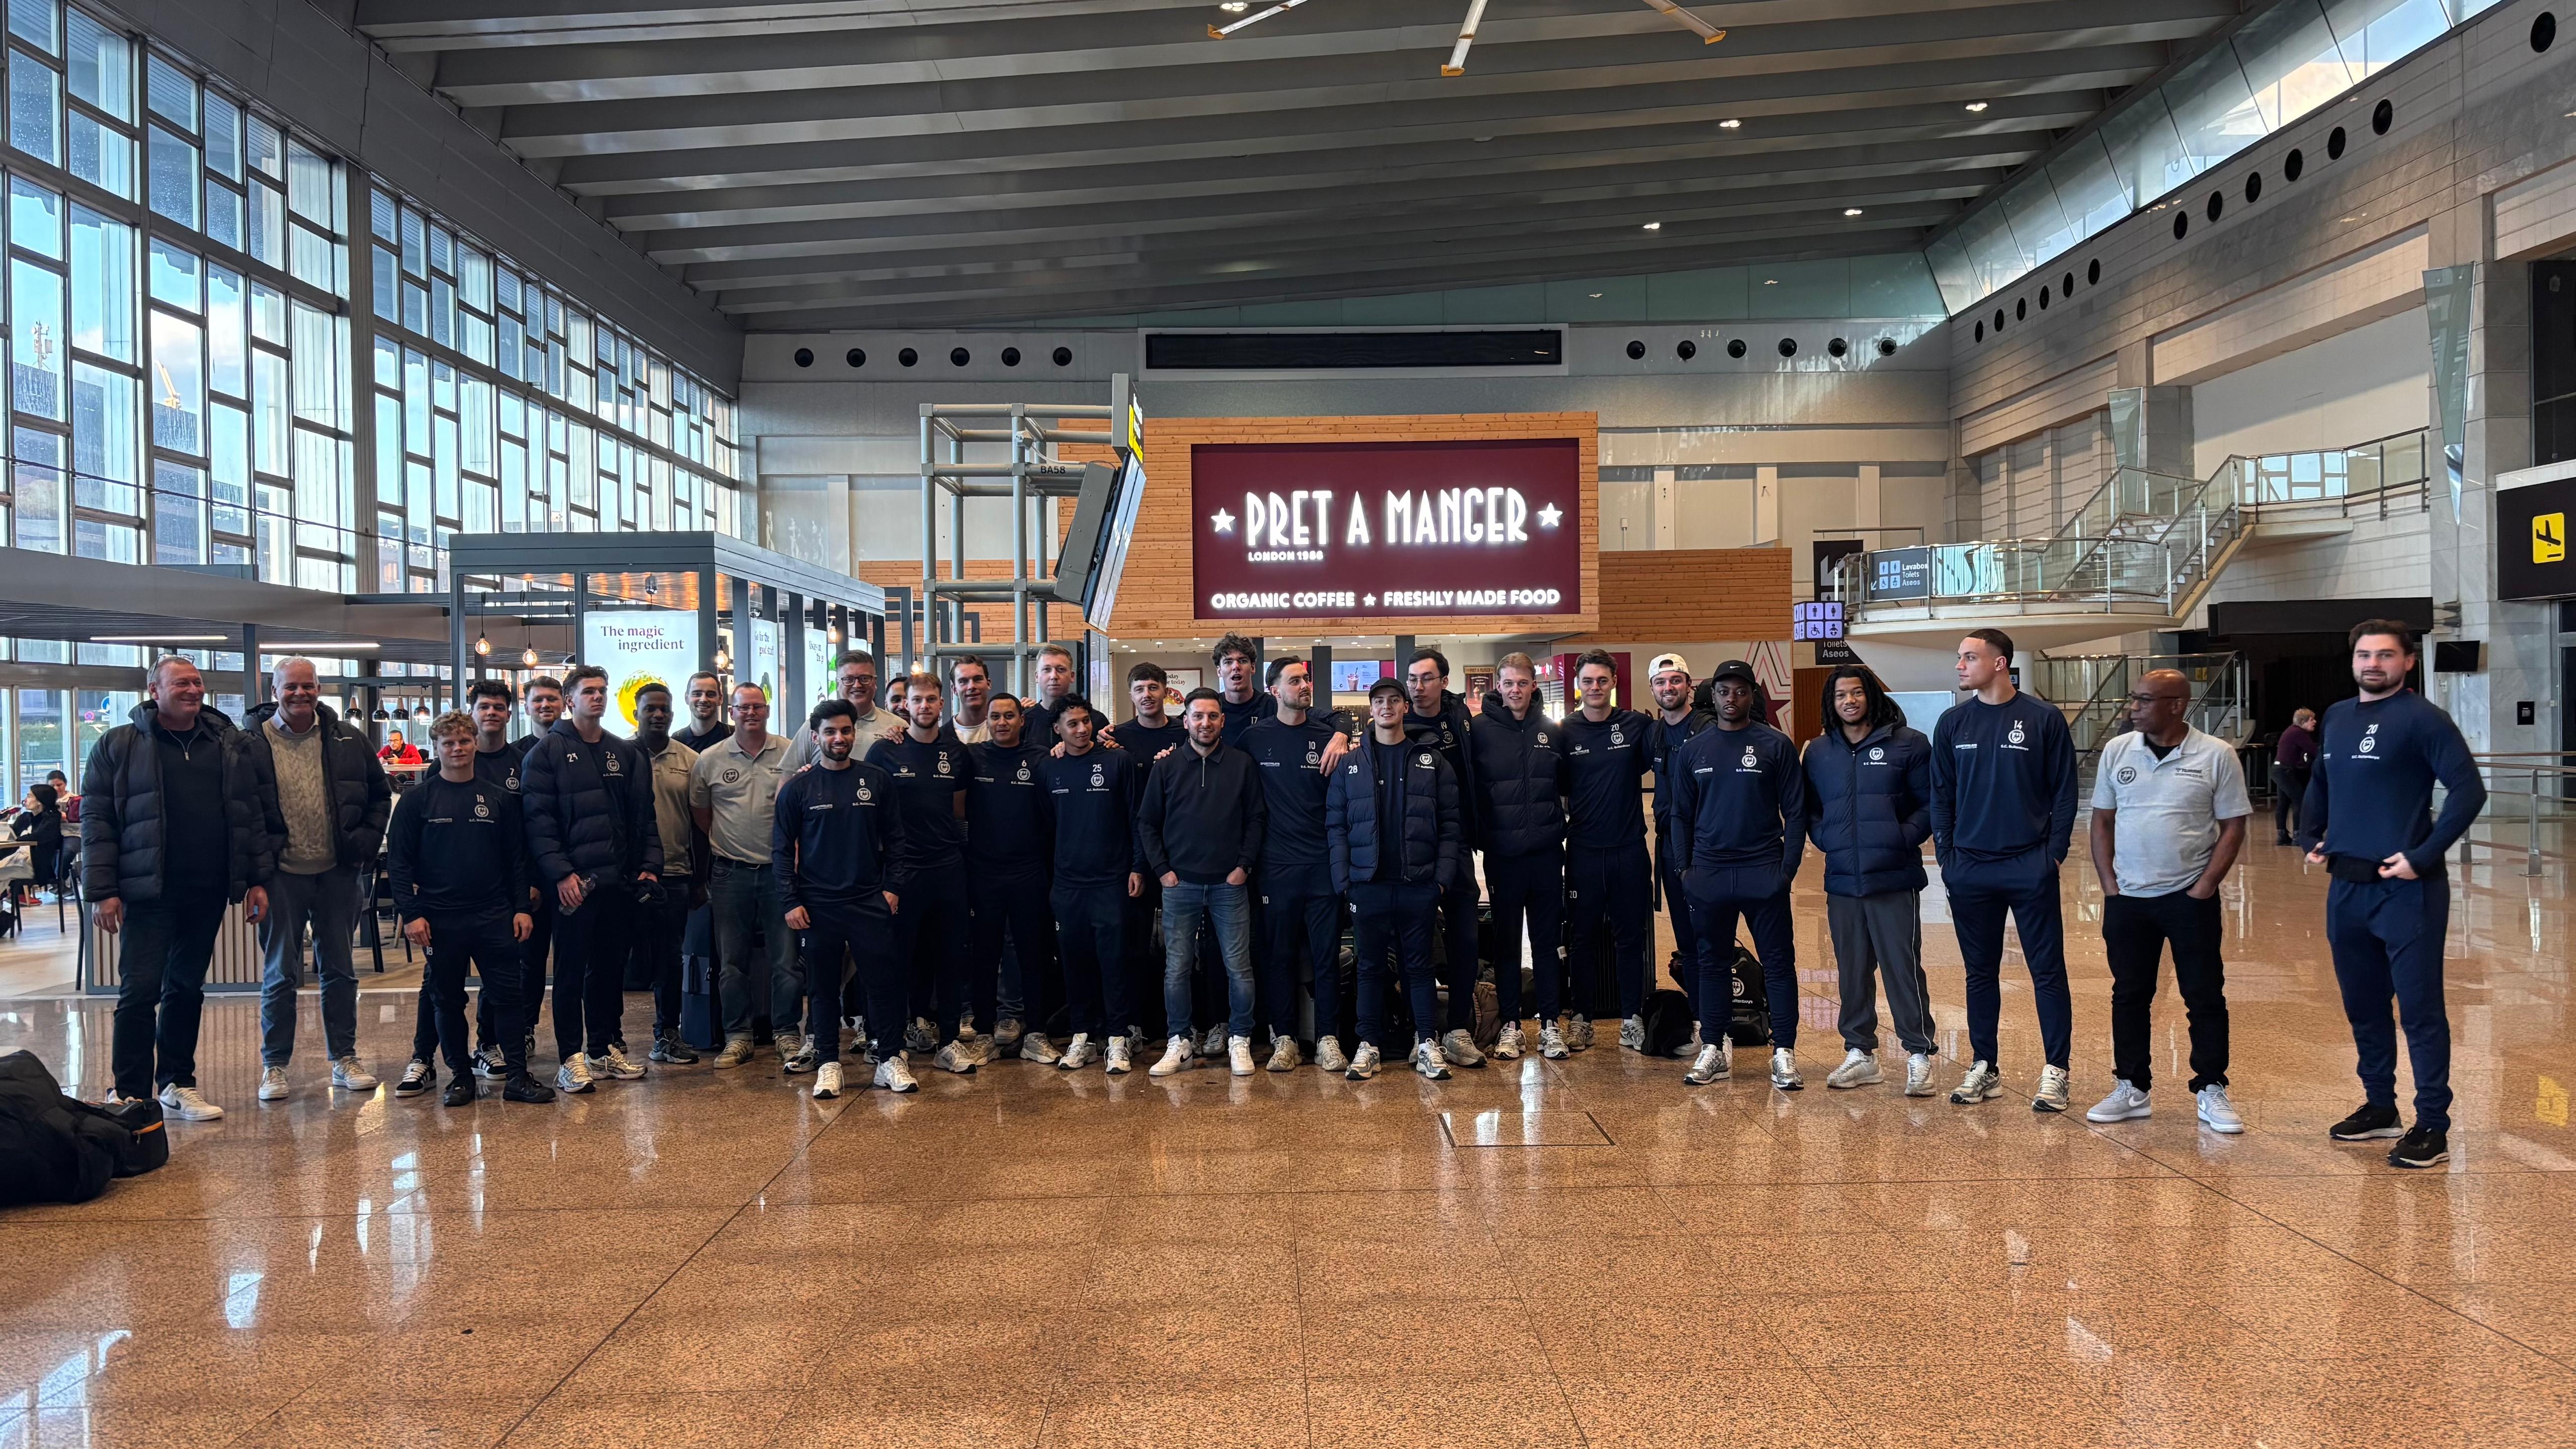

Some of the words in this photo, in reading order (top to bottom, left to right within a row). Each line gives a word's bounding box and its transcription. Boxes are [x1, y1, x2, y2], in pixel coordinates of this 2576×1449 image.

[1040, 466, 1066, 474] BA58
[1246, 490, 1332, 547] PRET
[1347, 491, 1370, 545] A
[1387, 487, 1527, 544] MANGER
[1248, 551, 1295, 561] LONDON
[1902, 562, 1928, 571] Lavabos
[1211, 593, 1290, 608] ORGANIC
[1293, 592, 1355, 607] COFFEE
[1384, 591, 1454, 607] FRESHLY
[1457, 590, 1506, 605] MADE
[1510, 589, 1560, 605] FOOD
[600, 626, 624, 636] The
[627, 625, 664, 639] magic
[618, 639, 684, 653] ingredient
[1822, 649, 1849, 658] Aseos
[1251, 716, 1258, 725] 17
[2014, 720, 2023, 730] 14
[1610, 723, 1620, 732] 20
[2366, 724, 2379, 735] 20
[1309, 741, 1316, 750] 10
[1745, 745, 1754, 754] 15
[939, 751, 948, 760] 22
[510, 768, 514, 776] 7
[1092, 764, 1102, 772] 25
[1348, 765, 1358, 775] 28
[859, 778, 865, 786] 8
[476, 794, 485, 803] 18
[1569, 890, 1577, 899] 20
[1262, 896, 1269, 904] 10
[1349, 903, 1356, 913] 28
[426, 945, 433, 955] 18
